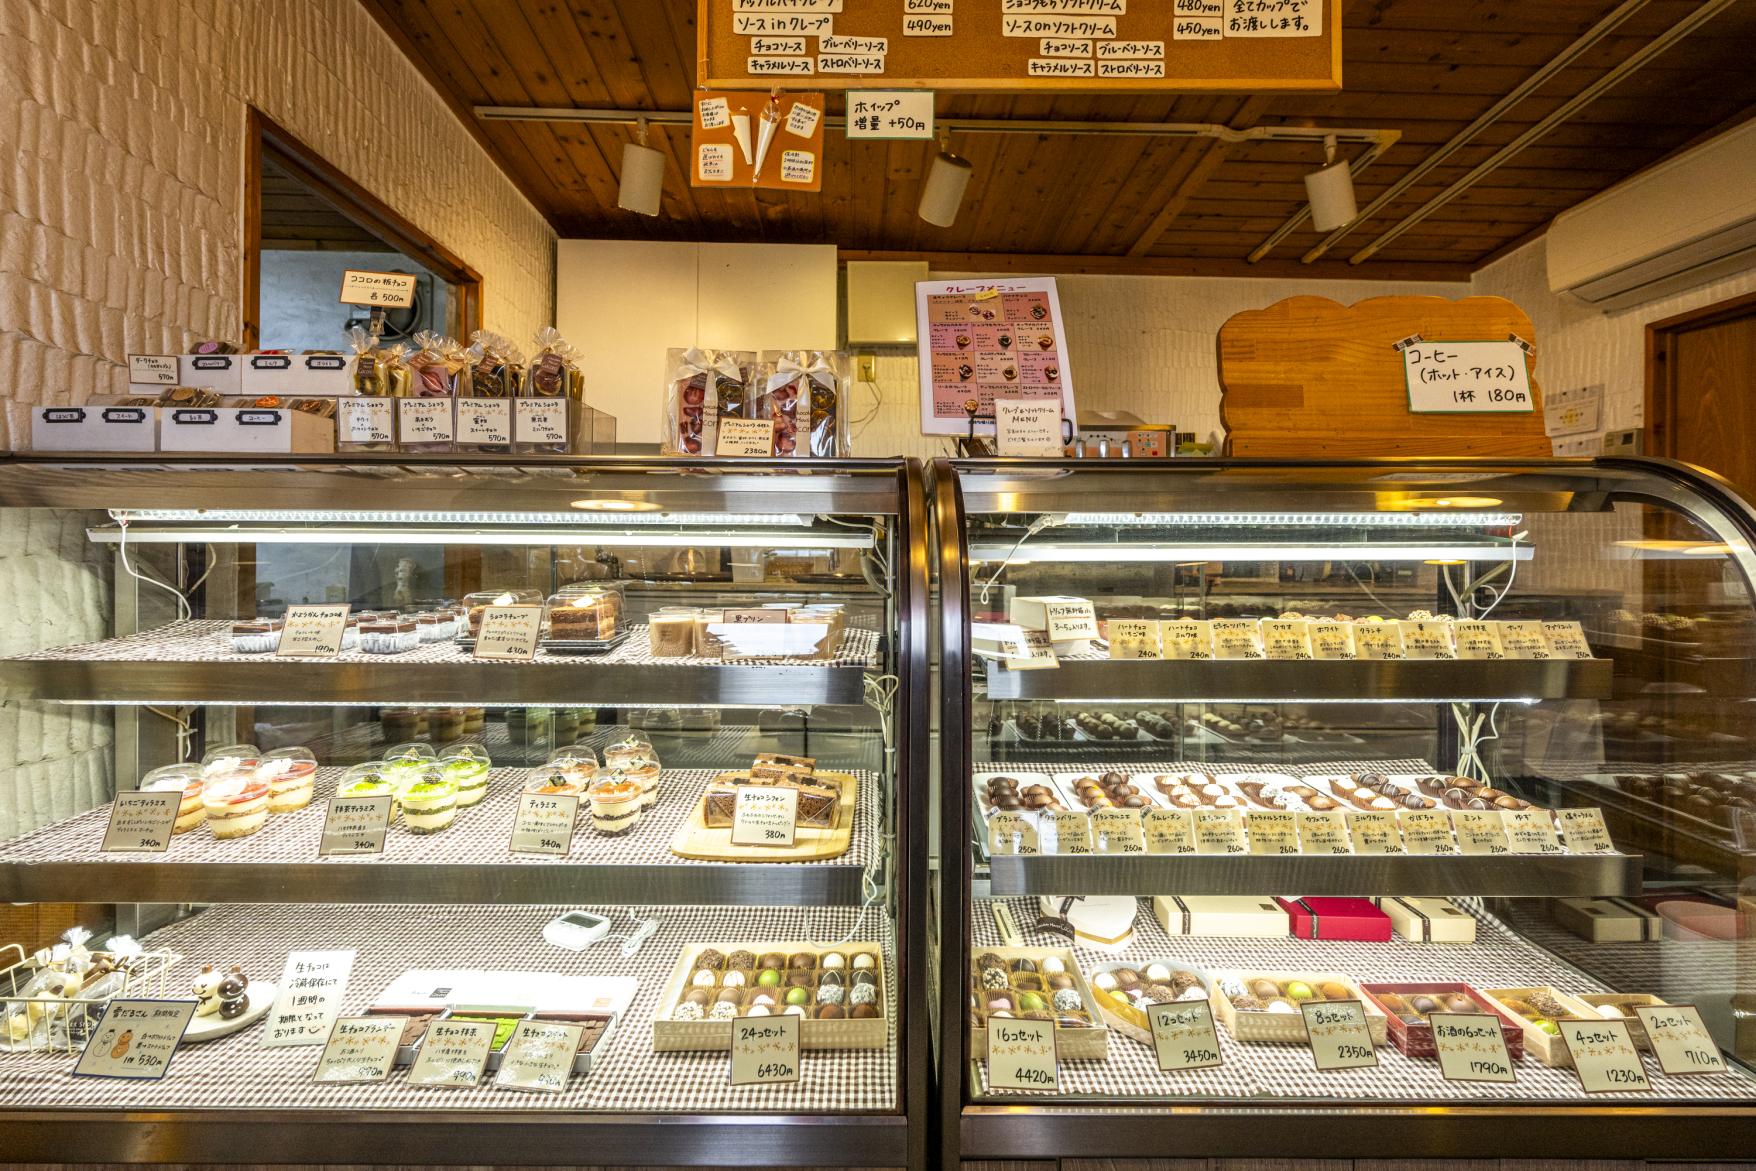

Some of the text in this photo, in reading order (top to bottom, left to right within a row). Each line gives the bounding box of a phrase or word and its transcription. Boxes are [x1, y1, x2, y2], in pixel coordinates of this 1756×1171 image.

[907, 20, 951, 32] 490yen
[1177, 23, 1220, 36] 450yen
[1230, 16, 1308, 32] お渡しします。
[754, 39, 802, 52] チョコソース
[822, 36, 886, 52] ブルーベリーソース
[1044, 41, 1089, 54] チョコソース
[1098, 43, 1162, 56] ブルーベリーソース
[750, 60, 811, 72] キャラメルソース
[820, 57, 882, 70] ストロベリーソース
[1030, 62, 1092, 74] キャラメルソース
[1100, 64, 1162, 75] ストロベリーソース
[854, 100, 900, 113] ホイップ
[854, 117, 925, 131] 増量 +50円
[1409, 350, 1458, 364] コーヒー
[1454, 390, 1526, 402] 1杯 180円
[1012, 416, 1038, 424] MENU
[734, 614, 764, 624] 黒プリン
[335, 804, 375, 813] 抹茶ティラミス
[530, 800, 557, 808] ティラミス
[765, 830, 786, 838] 380円
[140, 838, 160, 848] 340円
[354, 840, 374, 849] 340円
[540, 840, 560, 848] 340円
[1124, 844, 1142, 852] 260円
[1436, 844, 1454, 852] 260円
[296, 962, 330, 973] 生チョコは
[292, 995, 326, 1006] 1週間の
[1315, 1010, 1354, 1024] 8コセット
[1650, 1015, 1692, 1029] 2コセット
[274, 1026, 305, 1038] おります
[741, 1026, 787, 1040] 24コセット
[997, 1028, 1042, 1042] 16コセット
[1438, 1025, 1497, 1038] お酒の6コセット
[1576, 1030, 1618, 1044] 4コセット
[1183, 1050, 1218, 1063] 3450円
[1338, 1046, 1373, 1058] 2350円
[1685, 1050, 1720, 1065] 710円
[138, 1054, 162, 1066] 530円
[758, 1064, 793, 1078] 6430円
[1470, 1062, 1508, 1075] 1790円
[1016, 1067, 1054, 1084] 4420円
[1606, 1070, 1645, 1084] 1230円
